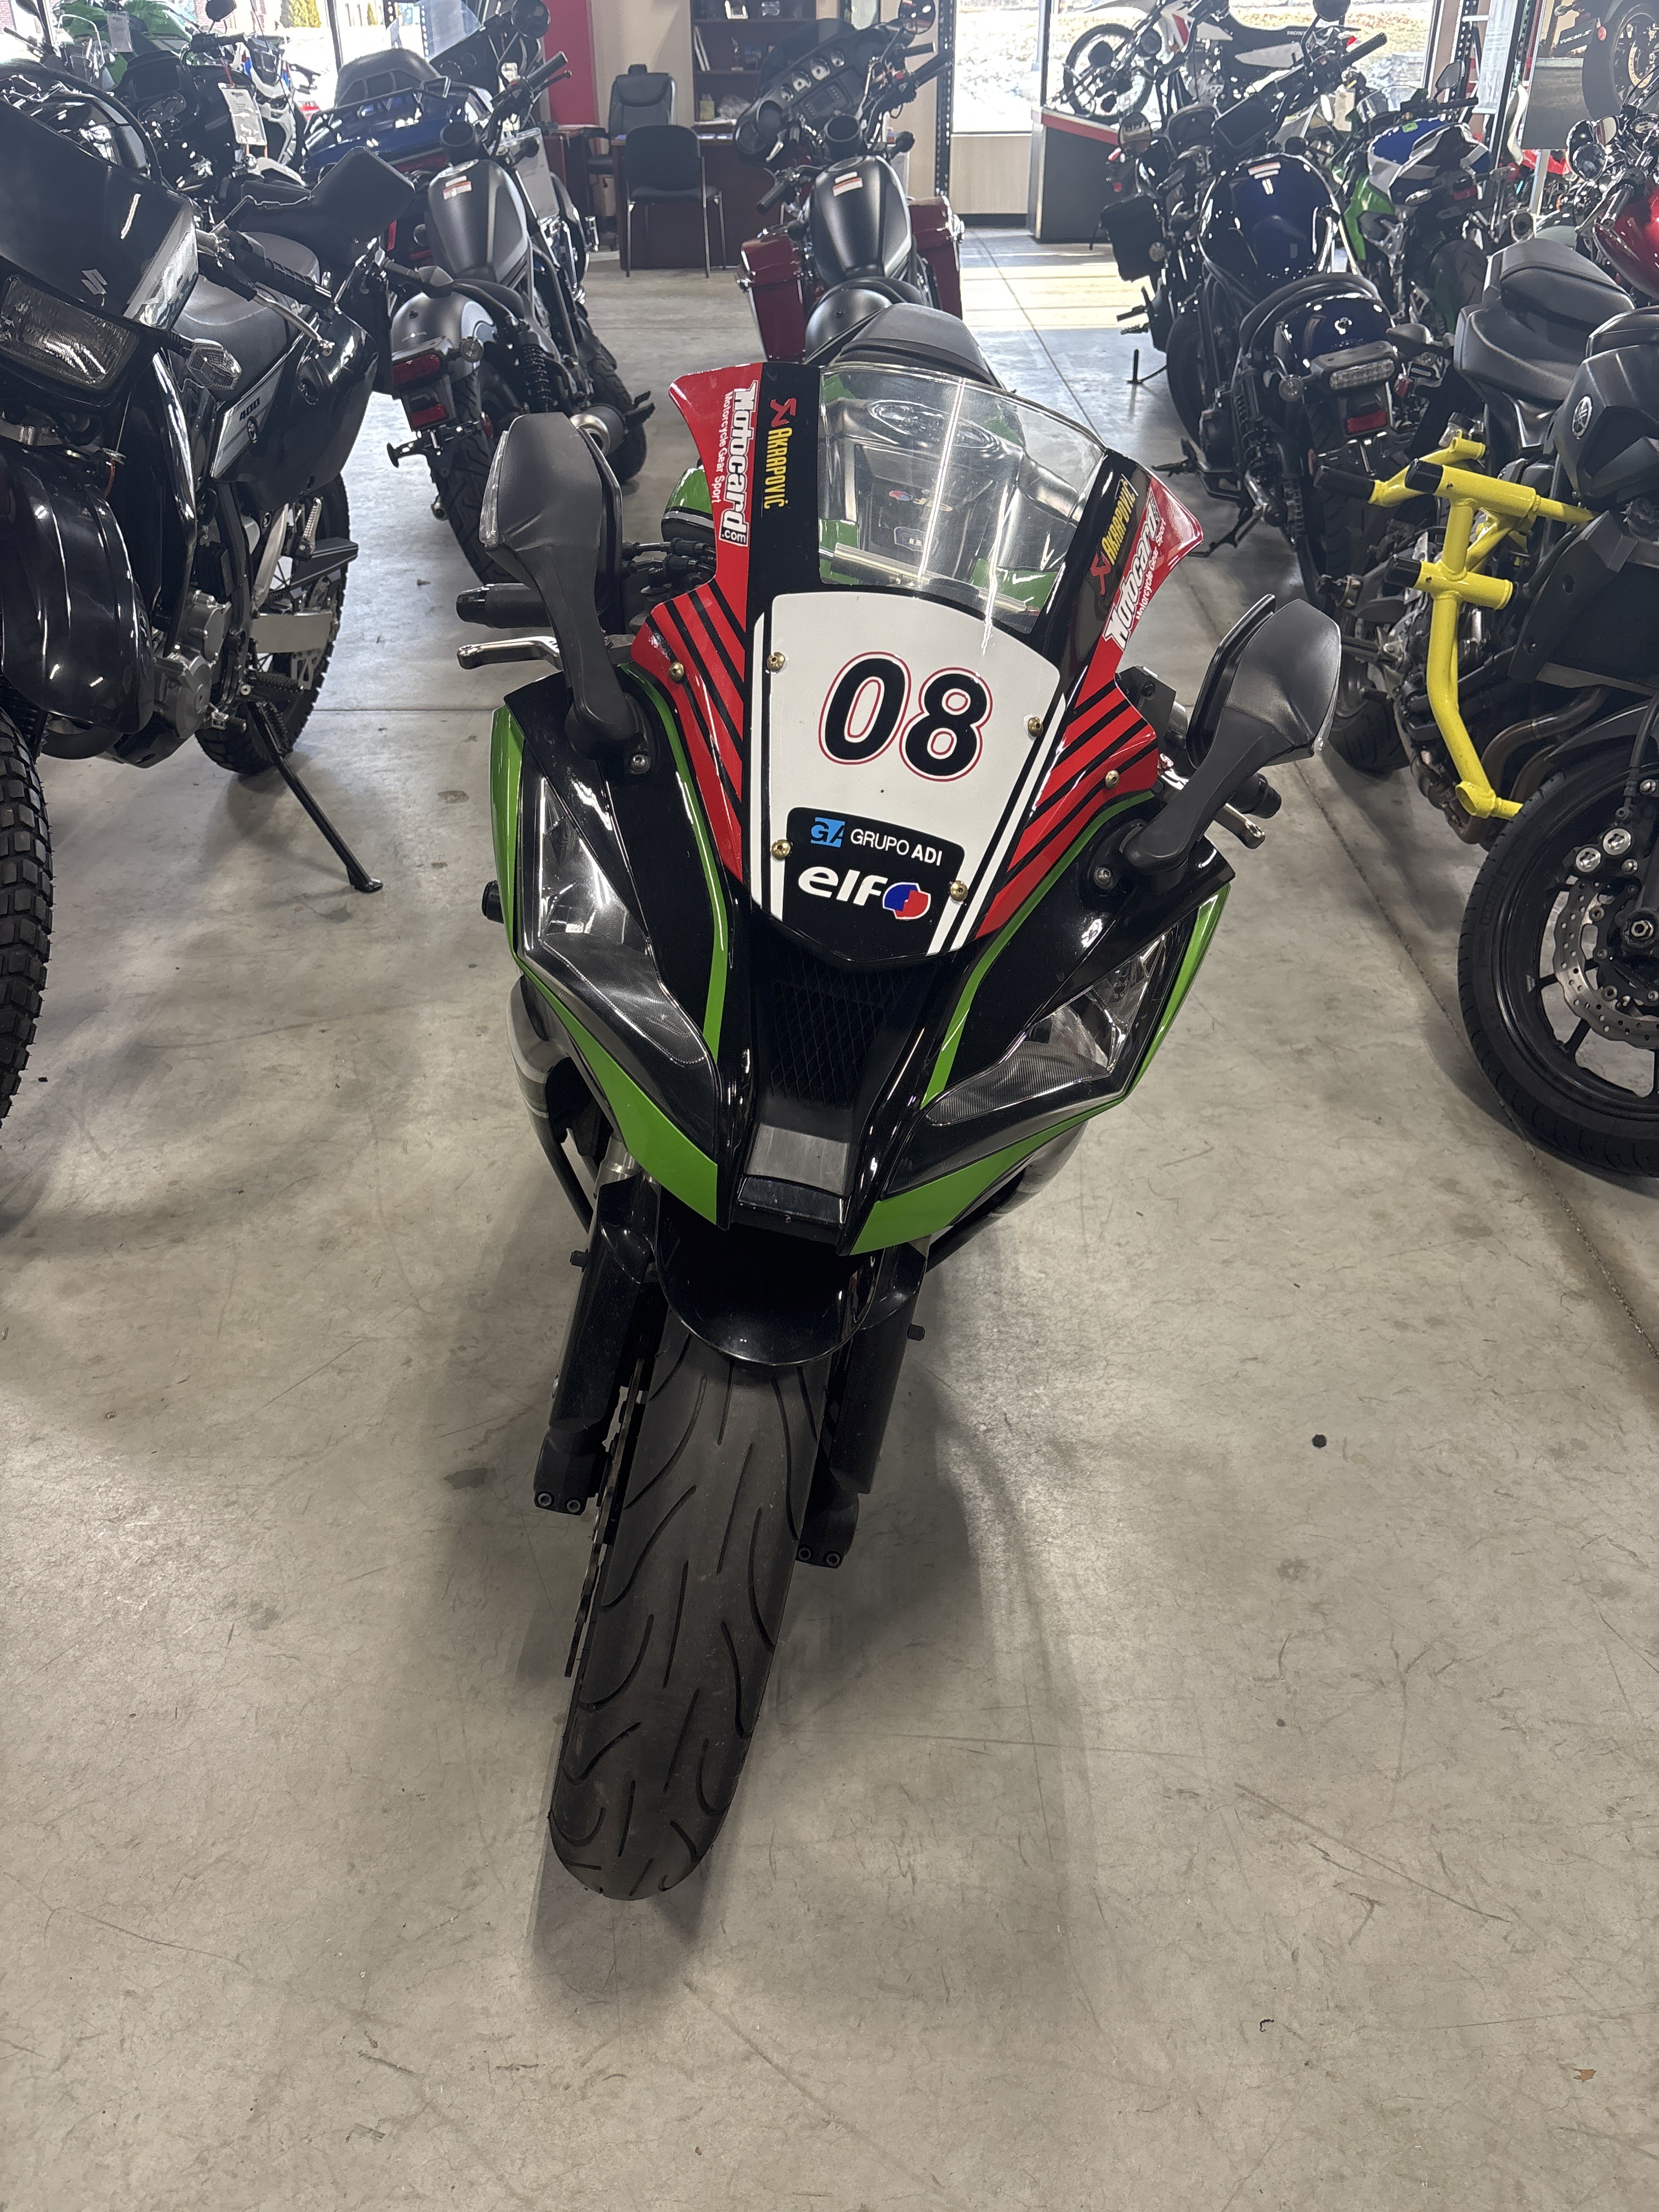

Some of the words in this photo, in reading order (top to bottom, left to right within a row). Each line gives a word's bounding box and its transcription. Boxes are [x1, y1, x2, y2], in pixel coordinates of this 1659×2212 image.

[239, 396, 261, 421] 400
[718, 391, 733, 448] Motorcycle
[715, 447, 728, 472] Gear
[722, 381, 758, 533] Motocard
[711, 475, 725, 504] Sport
[1103, 489, 1158, 650] Motocard
[1136, 572, 1154, 622] Motorcycle
[1149, 548, 1159, 571] Gear
[1155, 517, 1167, 546] Sport
[819, 651, 992, 782] 08
[850, 828, 910, 855] GRUPO
[911, 844, 943, 866] ADI
[798, 866, 888, 906] elf
